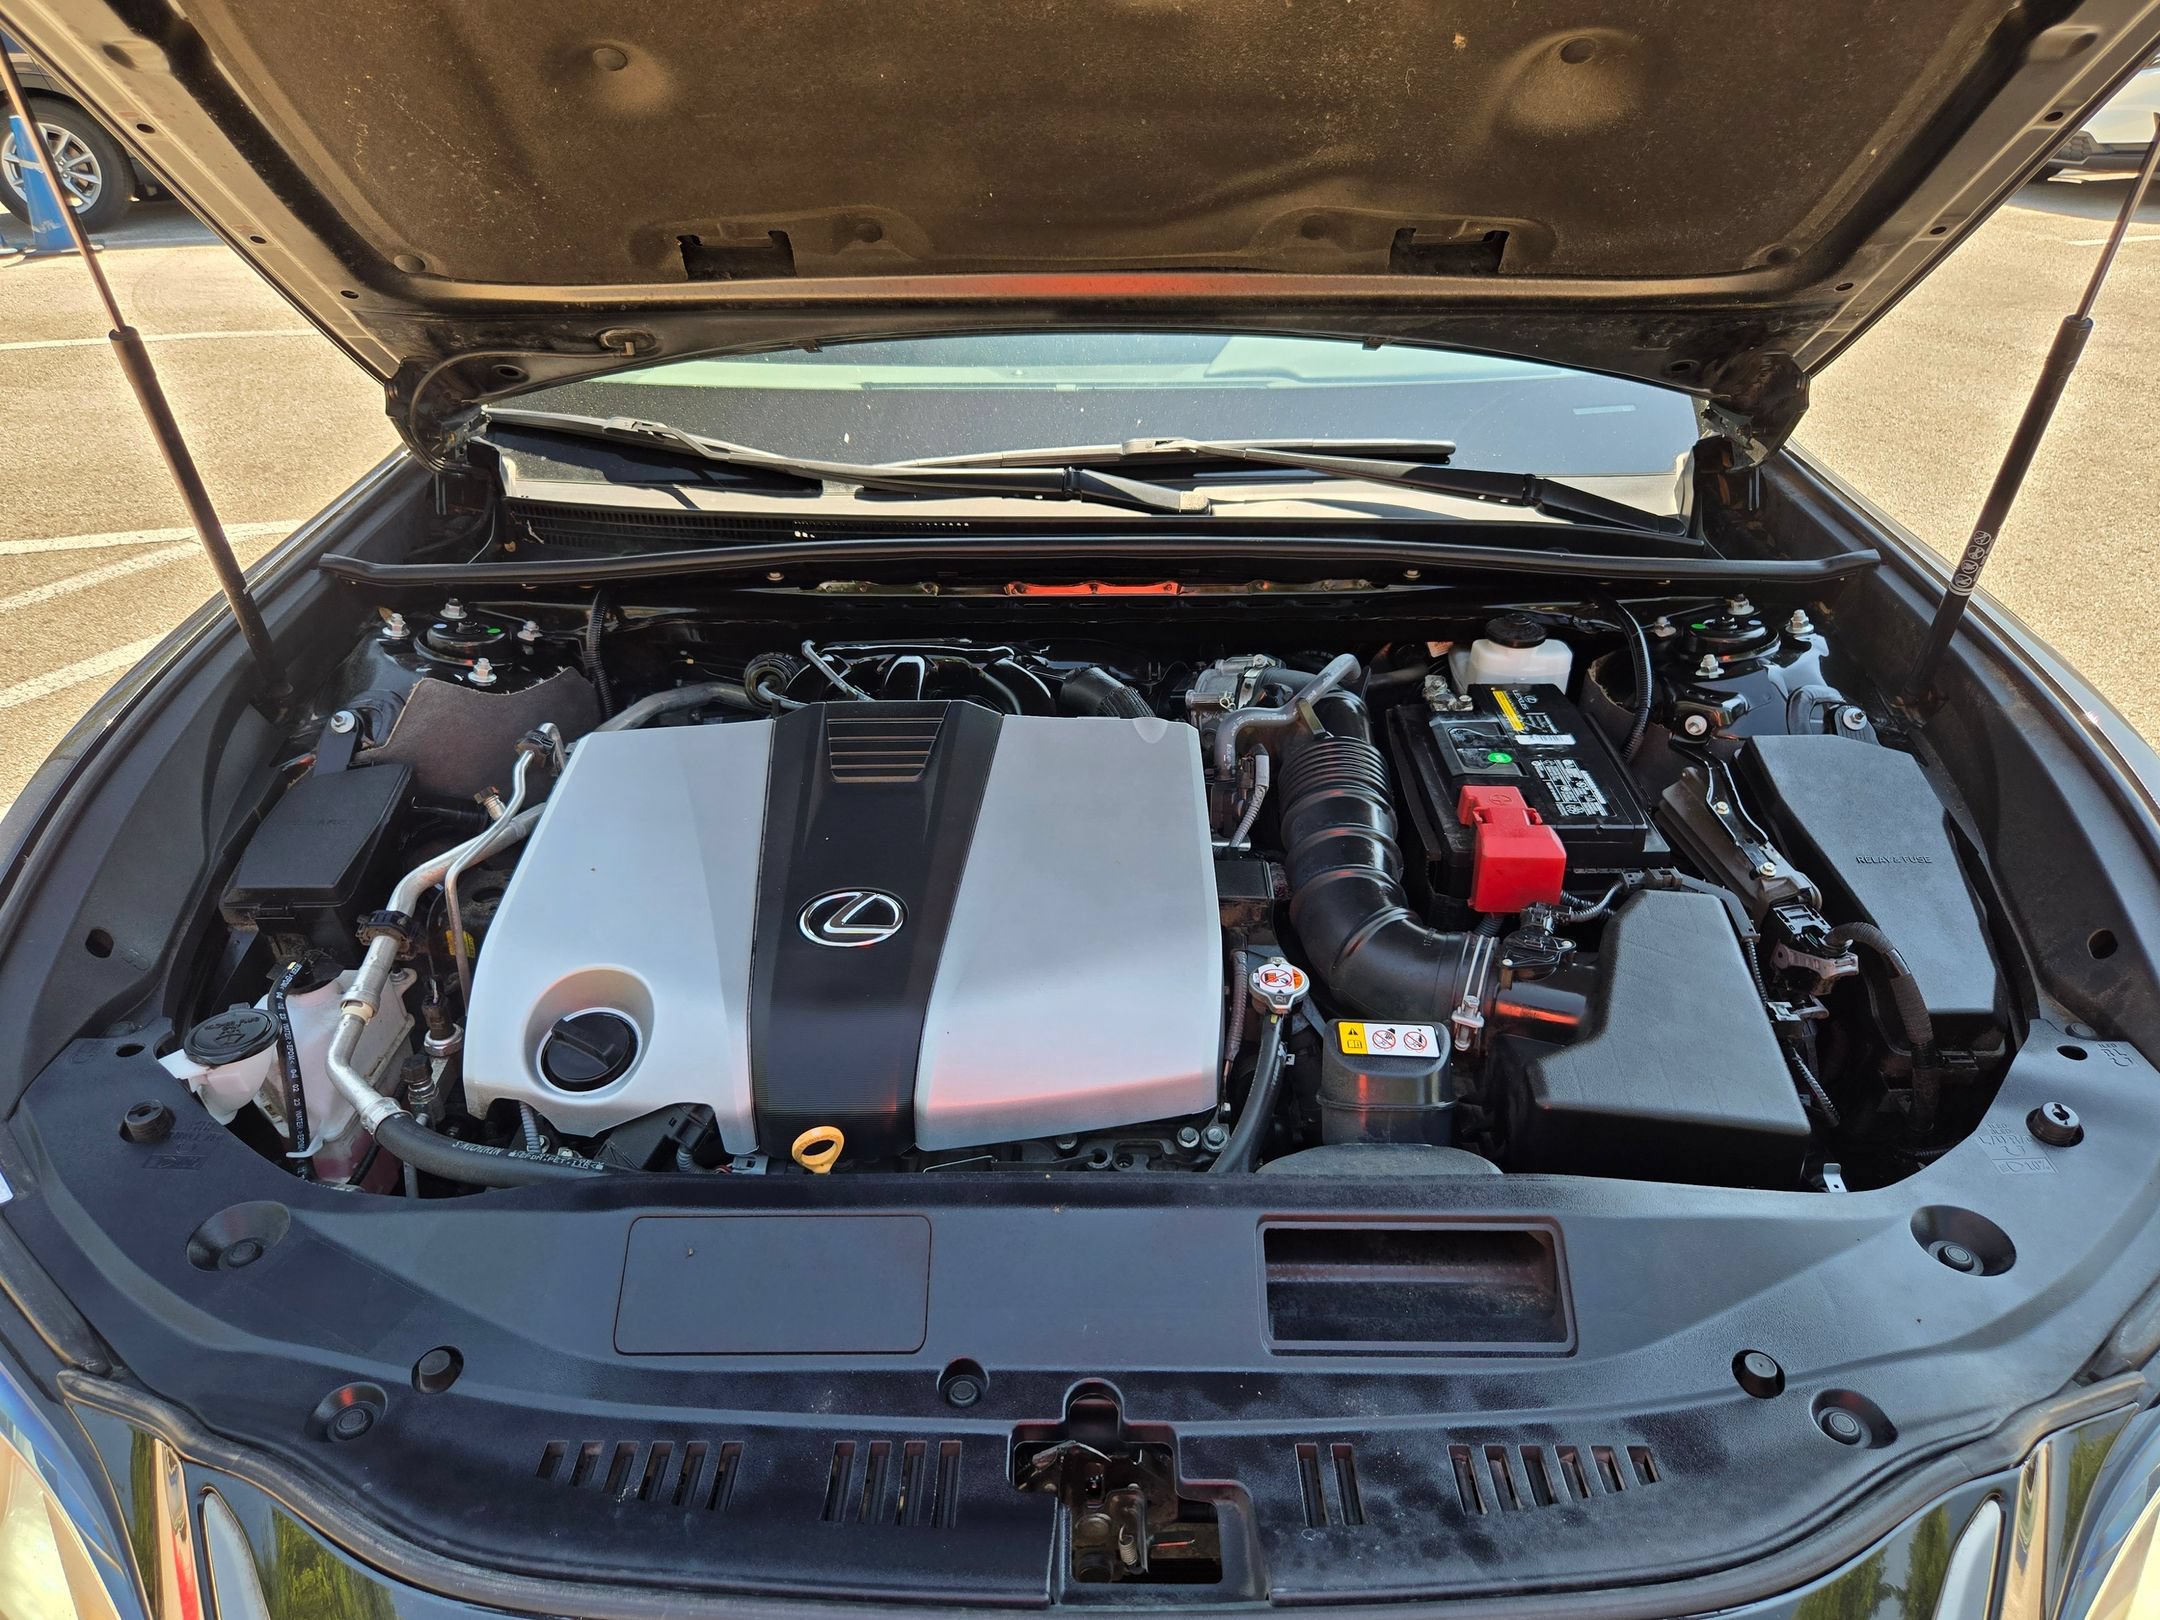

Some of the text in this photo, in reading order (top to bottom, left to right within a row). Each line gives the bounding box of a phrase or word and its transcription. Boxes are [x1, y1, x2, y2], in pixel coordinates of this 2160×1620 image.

[1511, 689, 1529, 710] LEXUS
[1855, 855, 1890, 864] RELAY
[1902, 856, 1933, 864] FUSE
